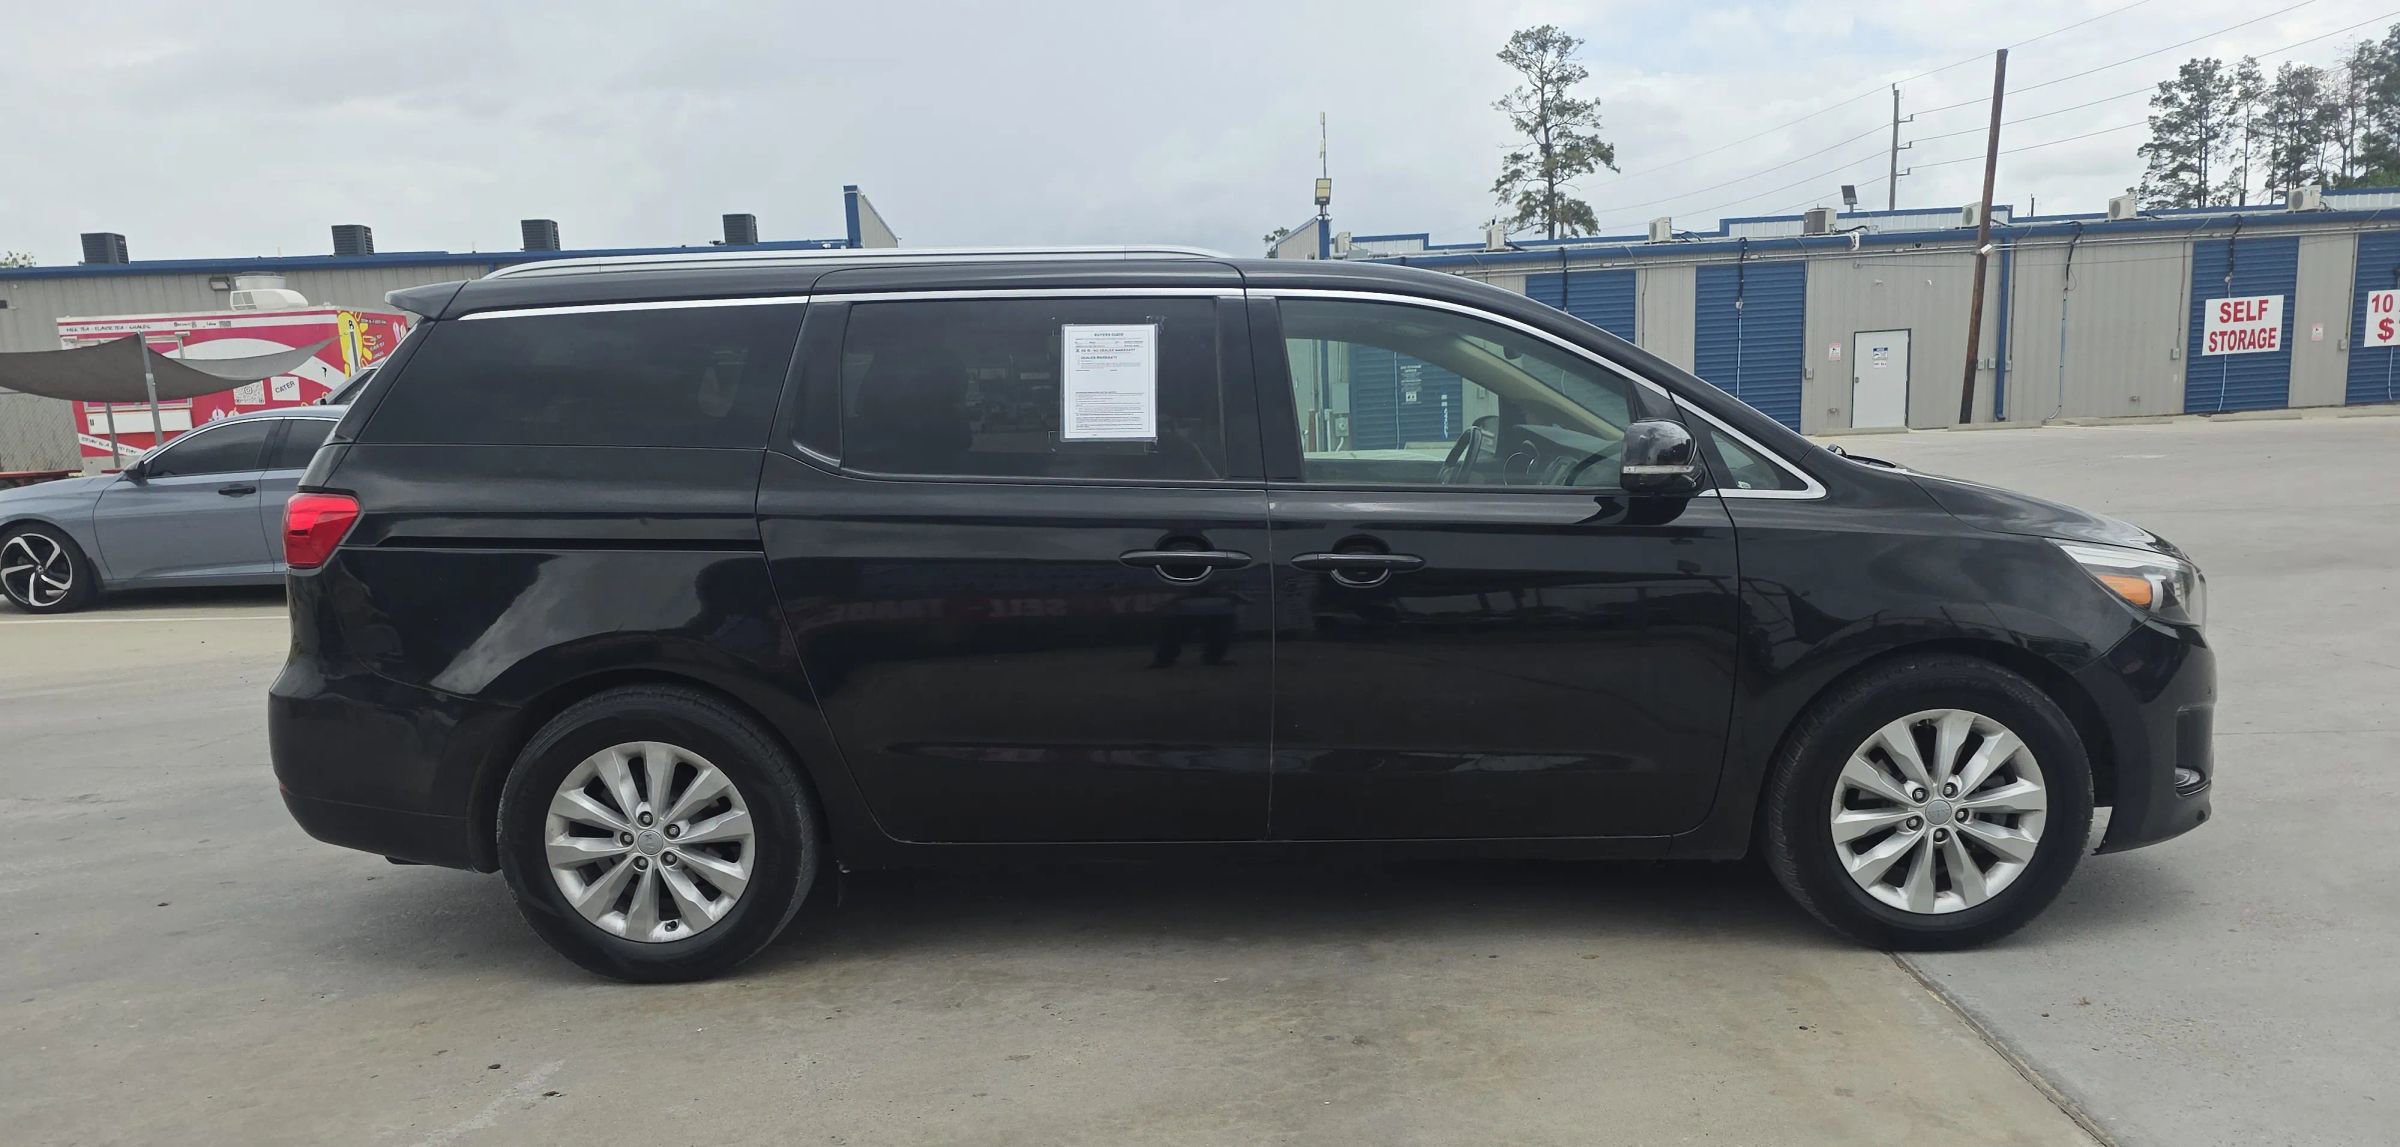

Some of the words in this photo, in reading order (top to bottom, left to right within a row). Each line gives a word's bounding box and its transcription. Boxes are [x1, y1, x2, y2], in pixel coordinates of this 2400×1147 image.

[2219, 299, 2269, 324] SELF
[2371, 293, 2394, 313] 10
[2208, 327, 2277, 352] STORAGE
[275, 380, 296, 394] CATER
